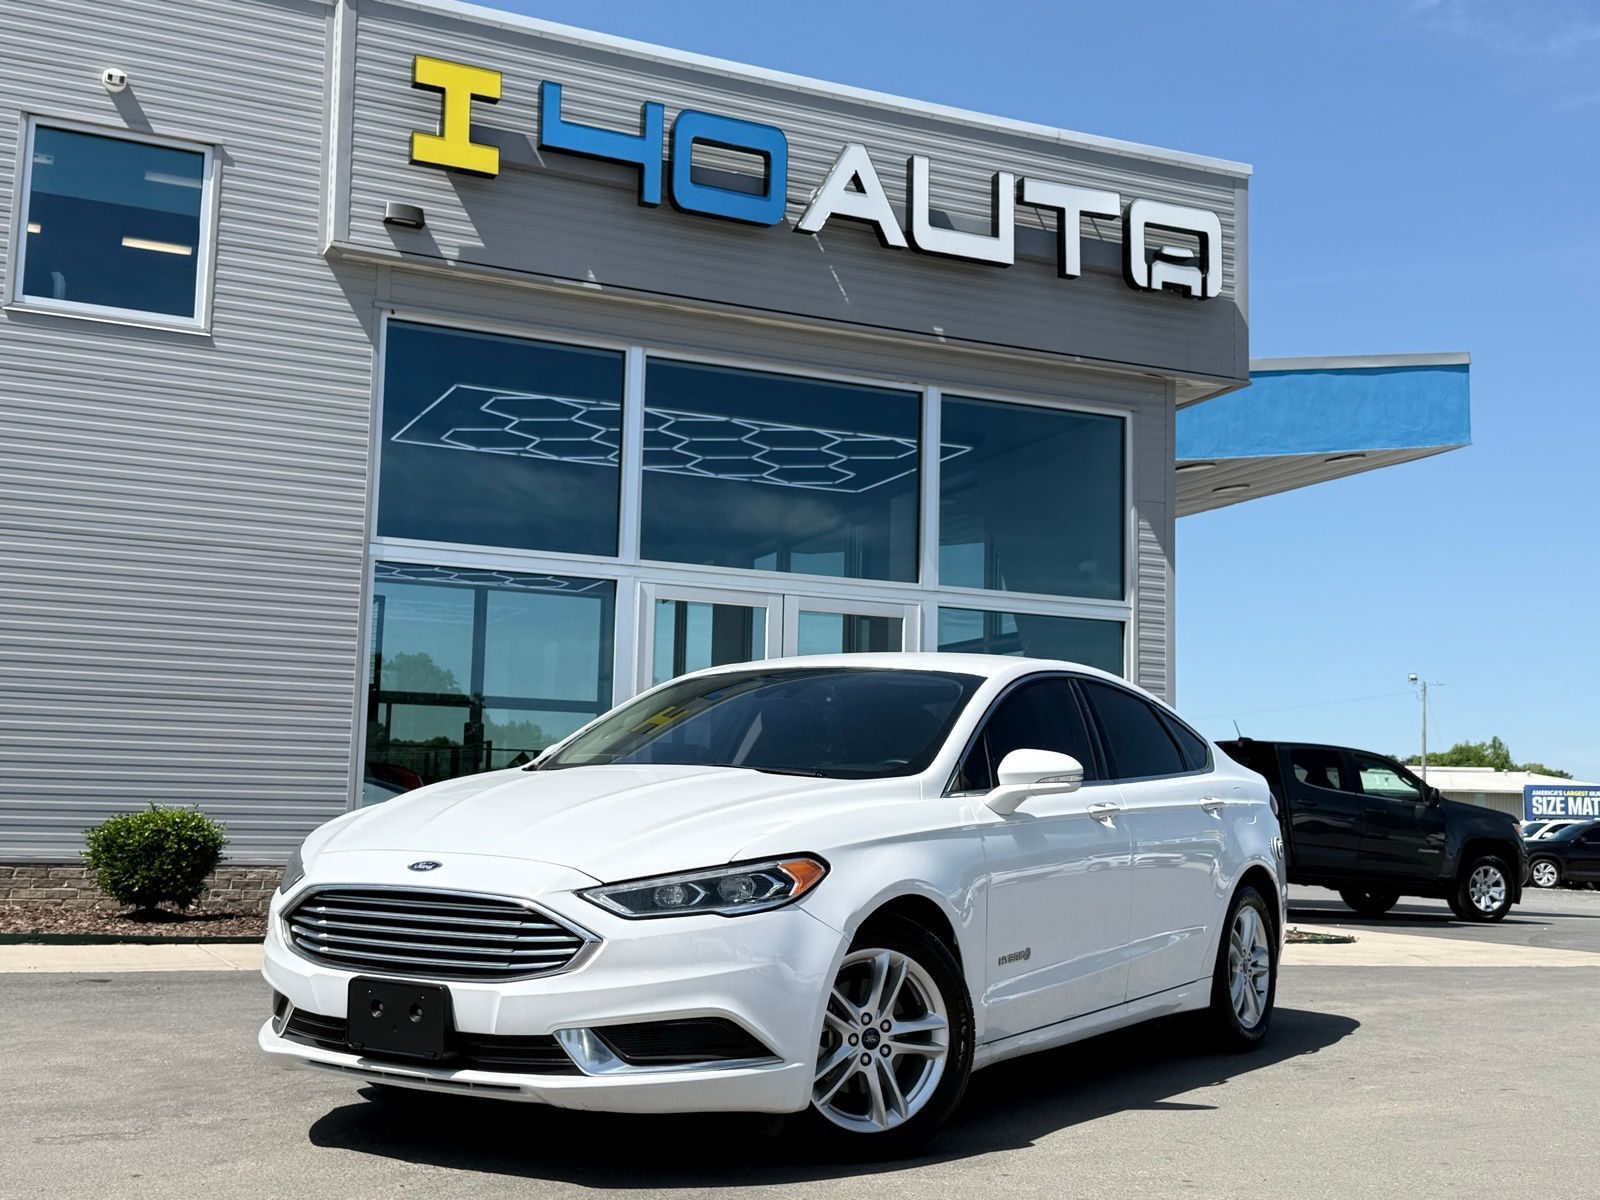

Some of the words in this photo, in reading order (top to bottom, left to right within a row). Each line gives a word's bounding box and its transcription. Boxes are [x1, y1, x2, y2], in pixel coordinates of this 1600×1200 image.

[411, 55, 502, 177] I
[538, 81, 789, 227] 40
[796, 142, 1223, 299] AUTO
[1532, 796, 1565, 815] SIZE
